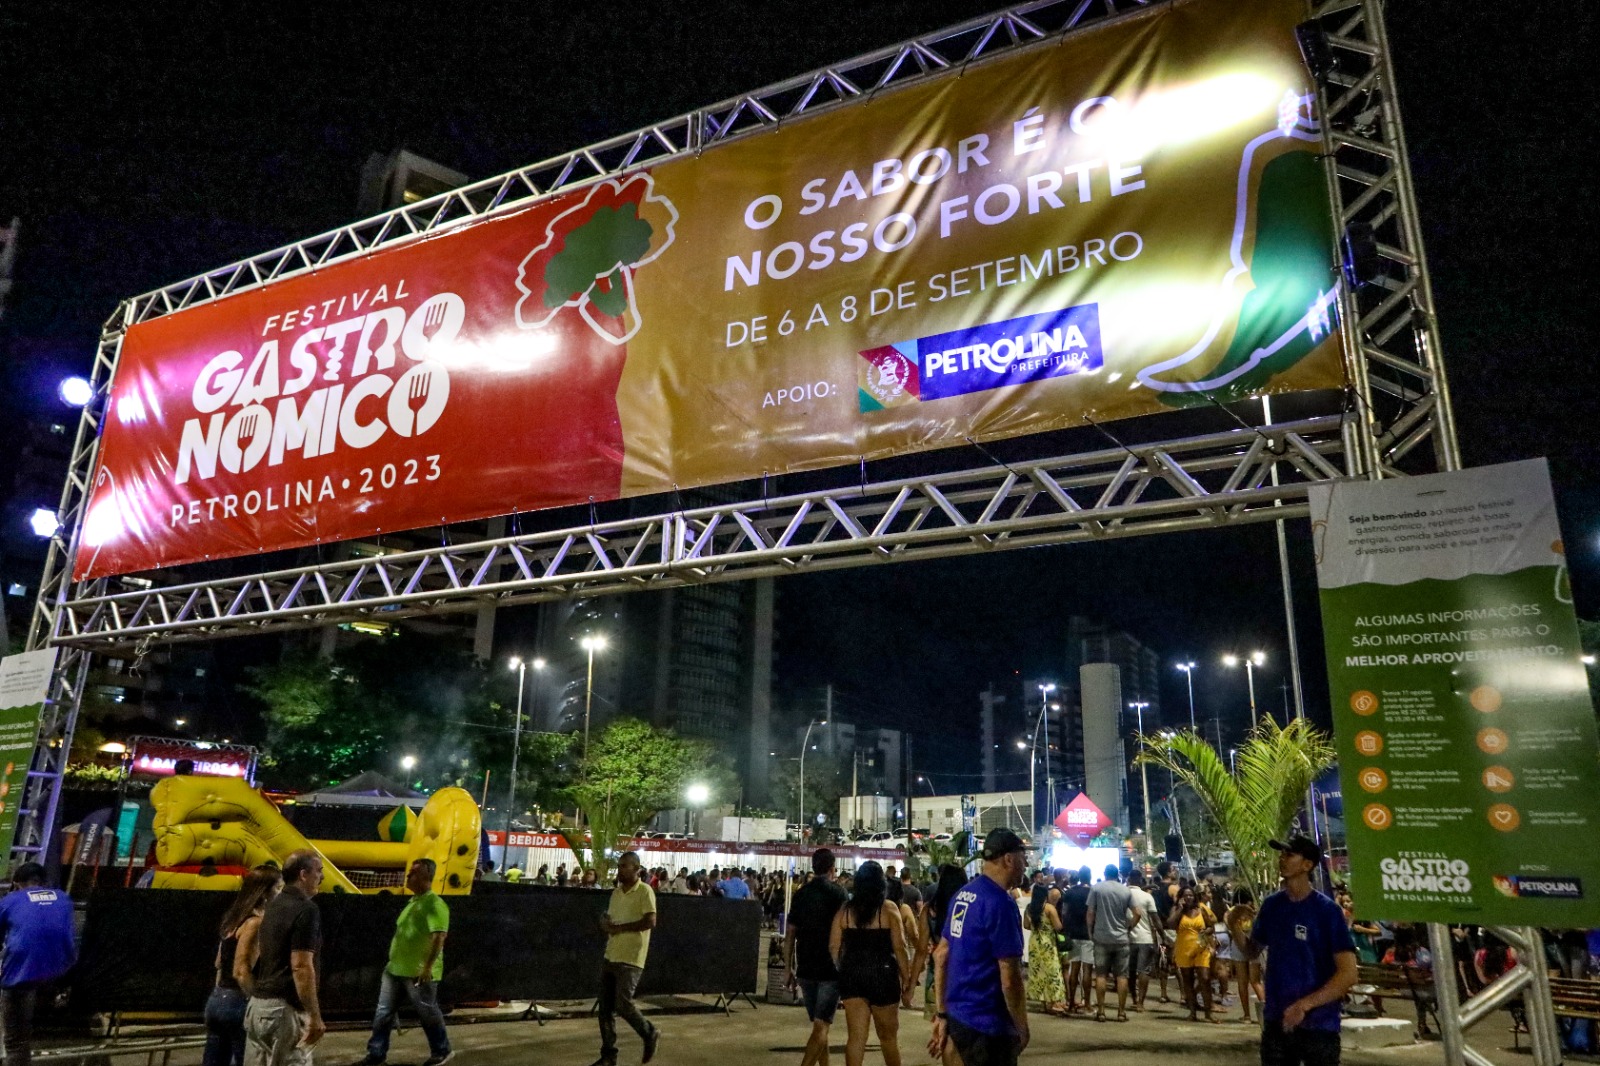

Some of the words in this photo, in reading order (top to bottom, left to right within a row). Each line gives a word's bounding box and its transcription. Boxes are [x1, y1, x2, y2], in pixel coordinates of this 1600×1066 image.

[744, 194, 783, 230] O
[799, 133, 991, 216] SABOR
[1013, 106, 1046, 156] É
[723, 212, 917, 291] NOSSO
[941, 157, 1146, 239] FORTE
[726, 315, 768, 347] DE
[777, 310, 796, 335] 6
[805, 303, 830, 330] A
[840, 296, 858, 322] 8
[870, 281, 917, 316] DE
[928, 231, 1143, 302] SETEMBRO
[262, 279, 410, 336] FESTIVAL
[192, 292, 466, 414] GASTRO
[925, 324, 1088, 378] PETROLINA
[1011, 351, 1089, 373] PREFEITURA
[761, 381, 837, 409] APOIO:
[171, 475, 336, 527] PETROLINA
[359, 455, 441, 493] 2023
[1349, 515, 1370, 524] Seja
[1372, 509, 1427, 521] bem-vindo
[1354, 613, 1425, 628] ALGUMAS
[1427, 603, 1542, 623] INFORMAÇÕES
[1351, 633, 1383, 648] SÃO
[1385, 628, 1488, 646] IMPORTANTES
[1491, 626, 1533, 639] PARA
[1535, 623, 1550, 636] O
[1346, 653, 1409, 667] MELHOR
[508, 834, 558, 847] BEBIDAS
[1380, 857, 1469, 876] GASTRO
[1398, 851, 1448, 859] FESTIVAL
[955, 890, 977, 903] APOIO
[1383, 893, 1442, 902] PETROLINA
[1519, 881, 1579, 895] PETROLINA
